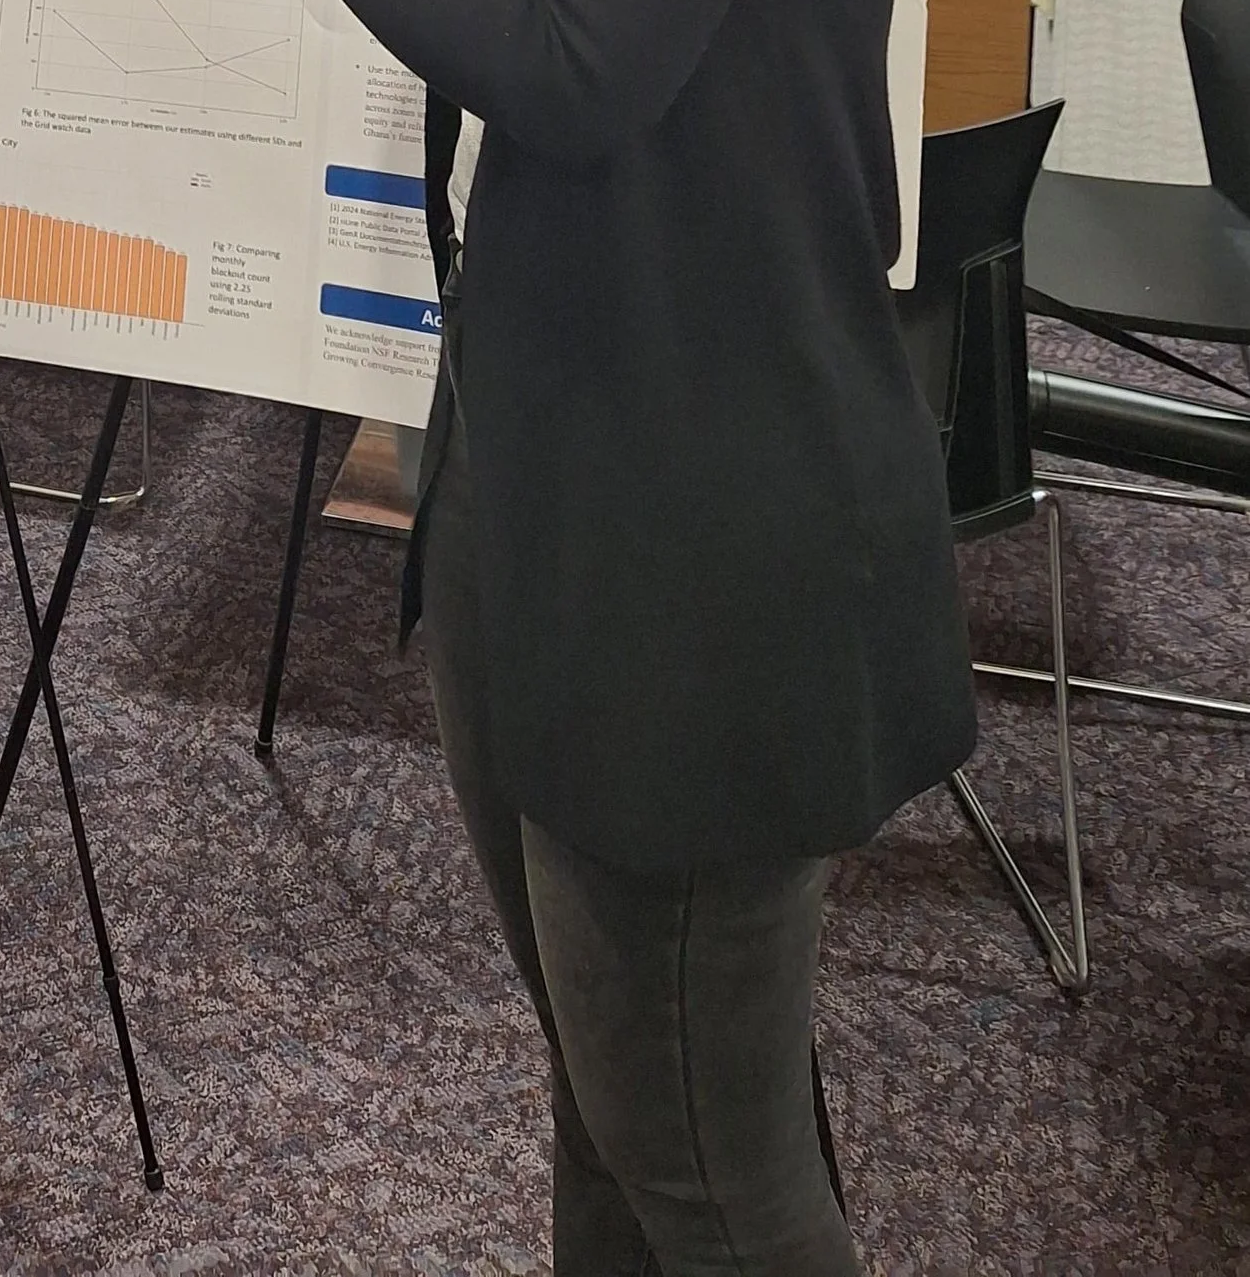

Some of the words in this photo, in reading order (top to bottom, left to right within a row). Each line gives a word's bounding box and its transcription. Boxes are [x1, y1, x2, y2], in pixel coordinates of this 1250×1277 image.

[2, 138, 18, 148] City
[213, 241, 224, 252] Fig
[236, 244, 280, 259] Comparing
[210, 281, 231, 291] using
[233, 282, 251, 292] 2.25
[209, 293, 234, 305] rolling
[237, 298, 272, 309] standard
[208, 306, 250, 318] deviations
